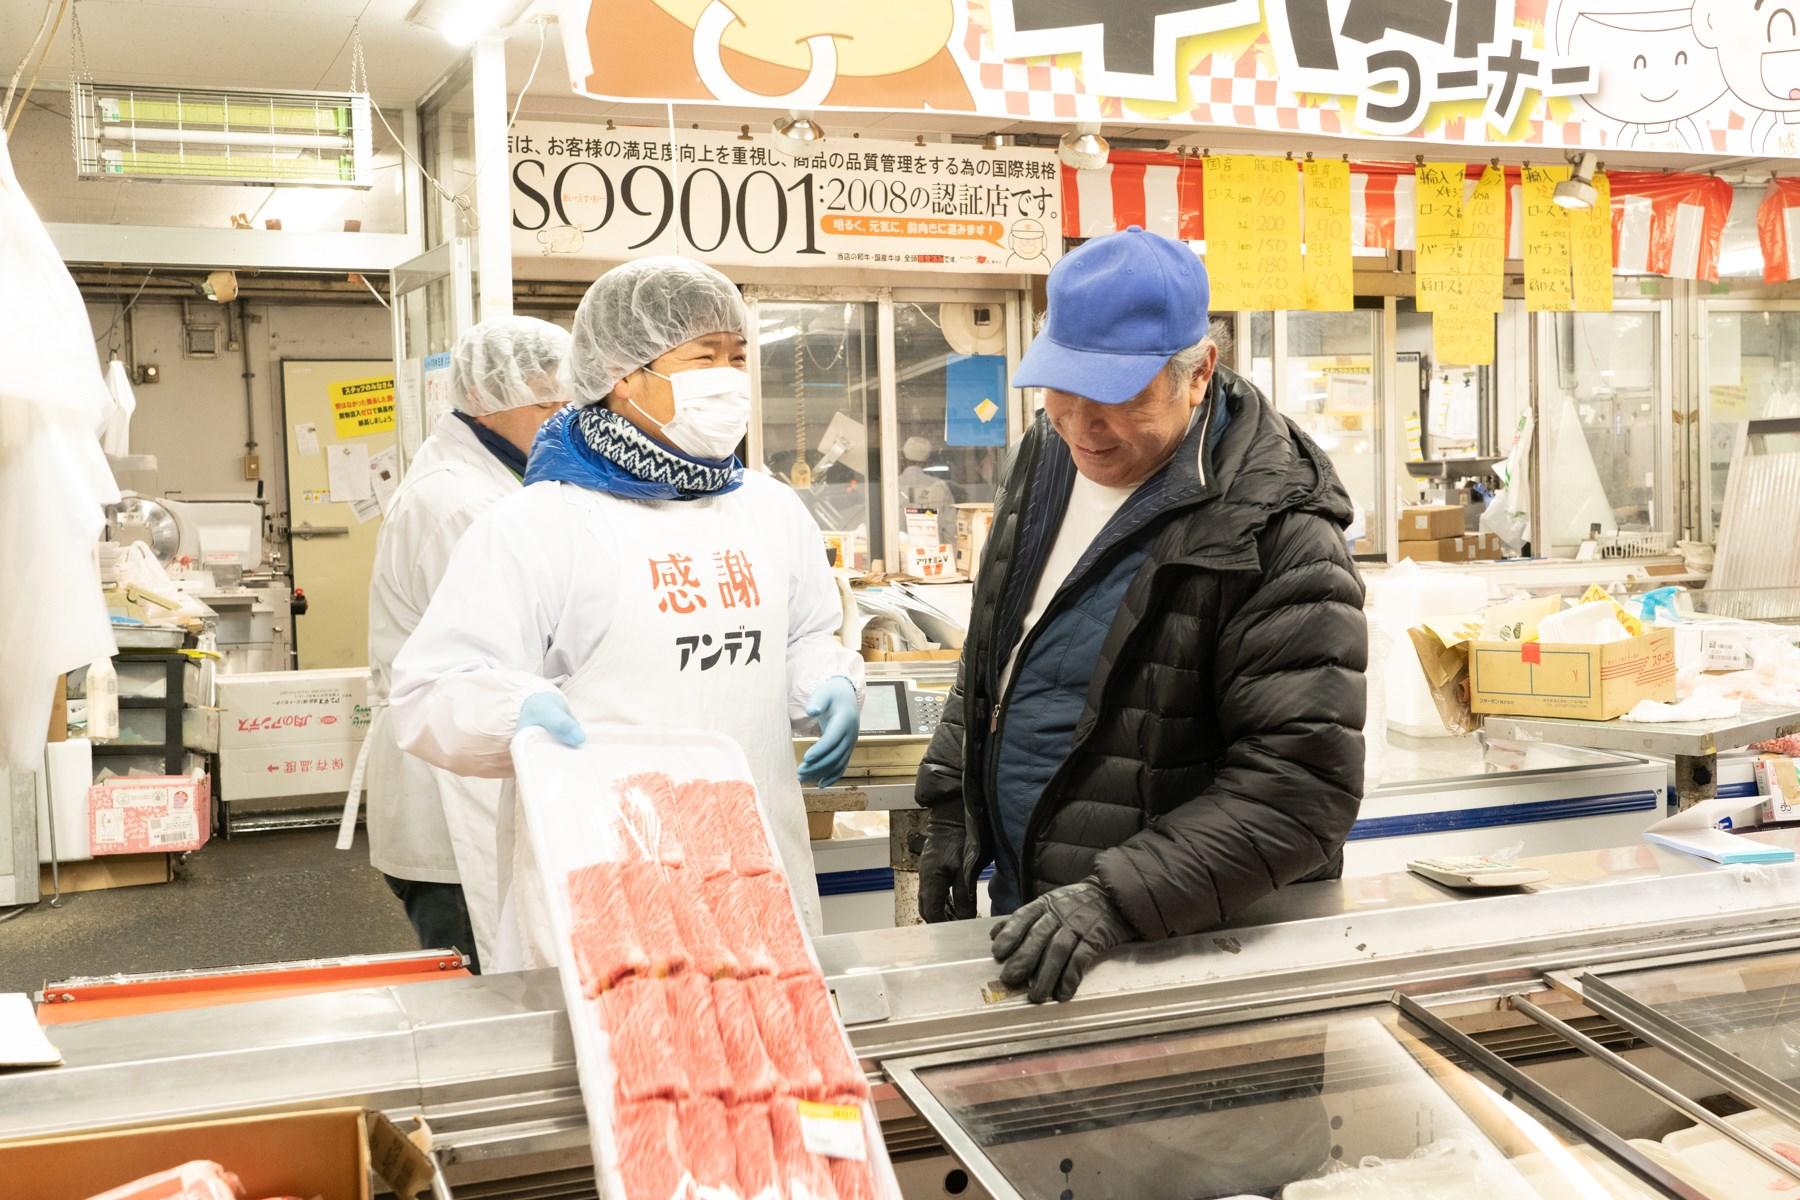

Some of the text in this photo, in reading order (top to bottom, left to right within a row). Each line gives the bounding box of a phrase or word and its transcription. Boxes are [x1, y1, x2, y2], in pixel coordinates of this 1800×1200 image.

[1366, 38, 1591, 124] コーナー
[648, 549, 761, 614] 感謝
[675, 625, 762, 672] アンデス
[237, 714, 312, 732] 肉のアンデス
[284, 758, 344, 774] 保存温度
